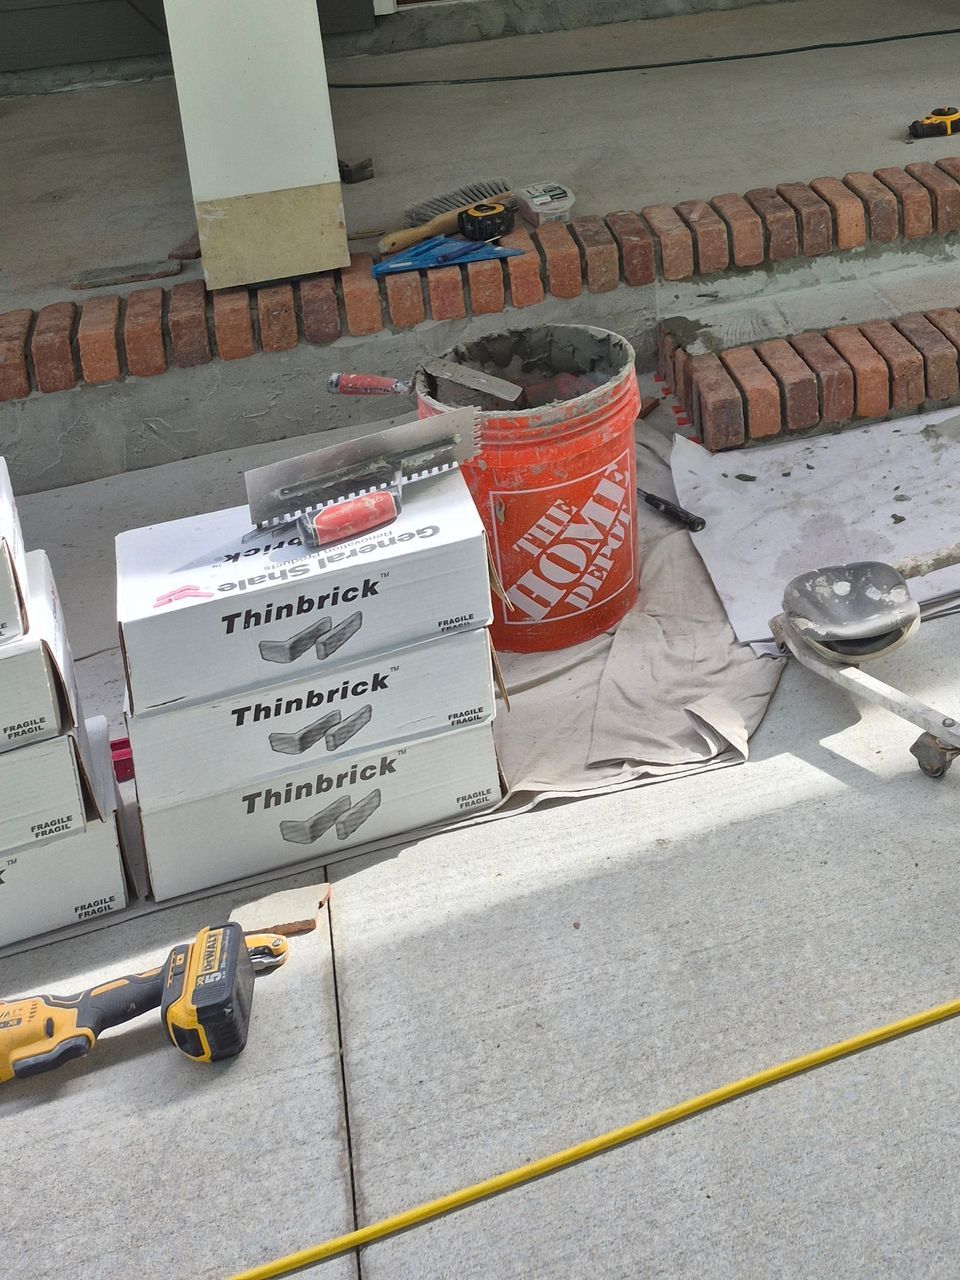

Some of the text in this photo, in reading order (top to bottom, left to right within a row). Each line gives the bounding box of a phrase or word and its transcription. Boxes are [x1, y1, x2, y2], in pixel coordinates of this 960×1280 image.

[512, 498, 578, 558] THE
[263, 530, 393, 571] Renovation Products
[505, 463, 631, 621] HOME
[217, 524, 441, 593] General Shale
[564, 503, 632, 610] DEPOT
[221, 578, 380, 634] Thinbrick
[438, 613, 475, 627] FRAGILE
[231, 672, 390, 726] Thinbrick
[448, 706, 484, 721] FRAGILE
[451, 714, 482, 726] FRAGIL
[3, 716, 47, 734] FRAGILE
[7, 725, 45, 740] FRAGIL
[242, 756, 400, 814] Thinbrick
[456, 788, 492, 803] FRAGILE
[459, 796, 491, 810] FRAGIL
[30, 815, 73, 834] FRAGILE
[34, 824, 72, 839] FRAGIL
[74, 895, 116, 914] FRAGILE
[77, 904, 114, 920] FRAGIL
[205, 971, 222, 984] 5
